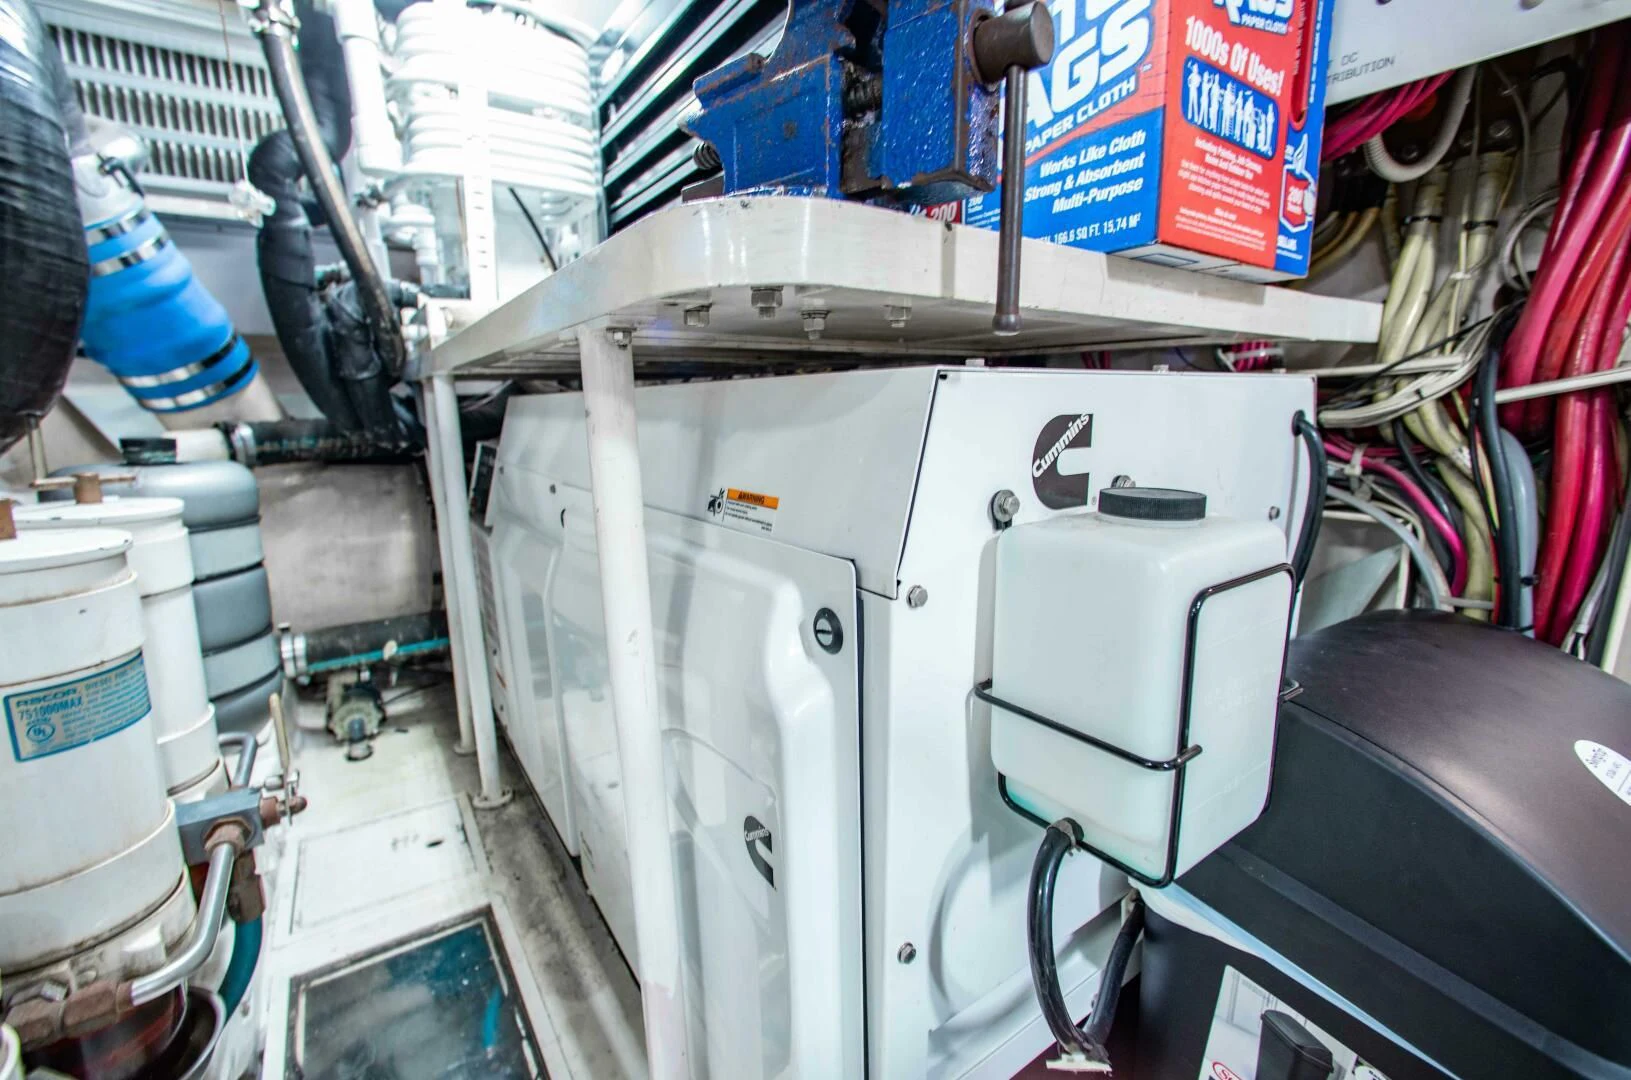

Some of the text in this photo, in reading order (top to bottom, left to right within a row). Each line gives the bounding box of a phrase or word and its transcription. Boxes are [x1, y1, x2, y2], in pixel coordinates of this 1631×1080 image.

[1241, 13, 1265, 30] PAPER
[1185, 15, 1230, 66] 1000s
[1230, 42, 1249, 76] Of
[1247, 52, 1285, 97] Uses!
[1327, 54, 1396, 84] TRIBUTION
[1341, 51, 1358, 66] DC
[1025, 73, 1136, 152] PAPER CLOTH
[1040, 129, 1146, 178] Works Like Cloth
[1024, 152, 1146, 203] Strong & Absorbent
[1052, 178, 1144, 214] Multi-Purpose
[1054, 230, 1075, 245] 166.6
[1076, 226, 1088, 240] SQ
[1089, 223, 1100, 237] FT.
[1103, 215, 1127, 235] 15,74
[1032, 412, 1090, 478] Cummins
[743, 491, 765, 505] WARNING
[744, 828, 770, 842] Cummins
